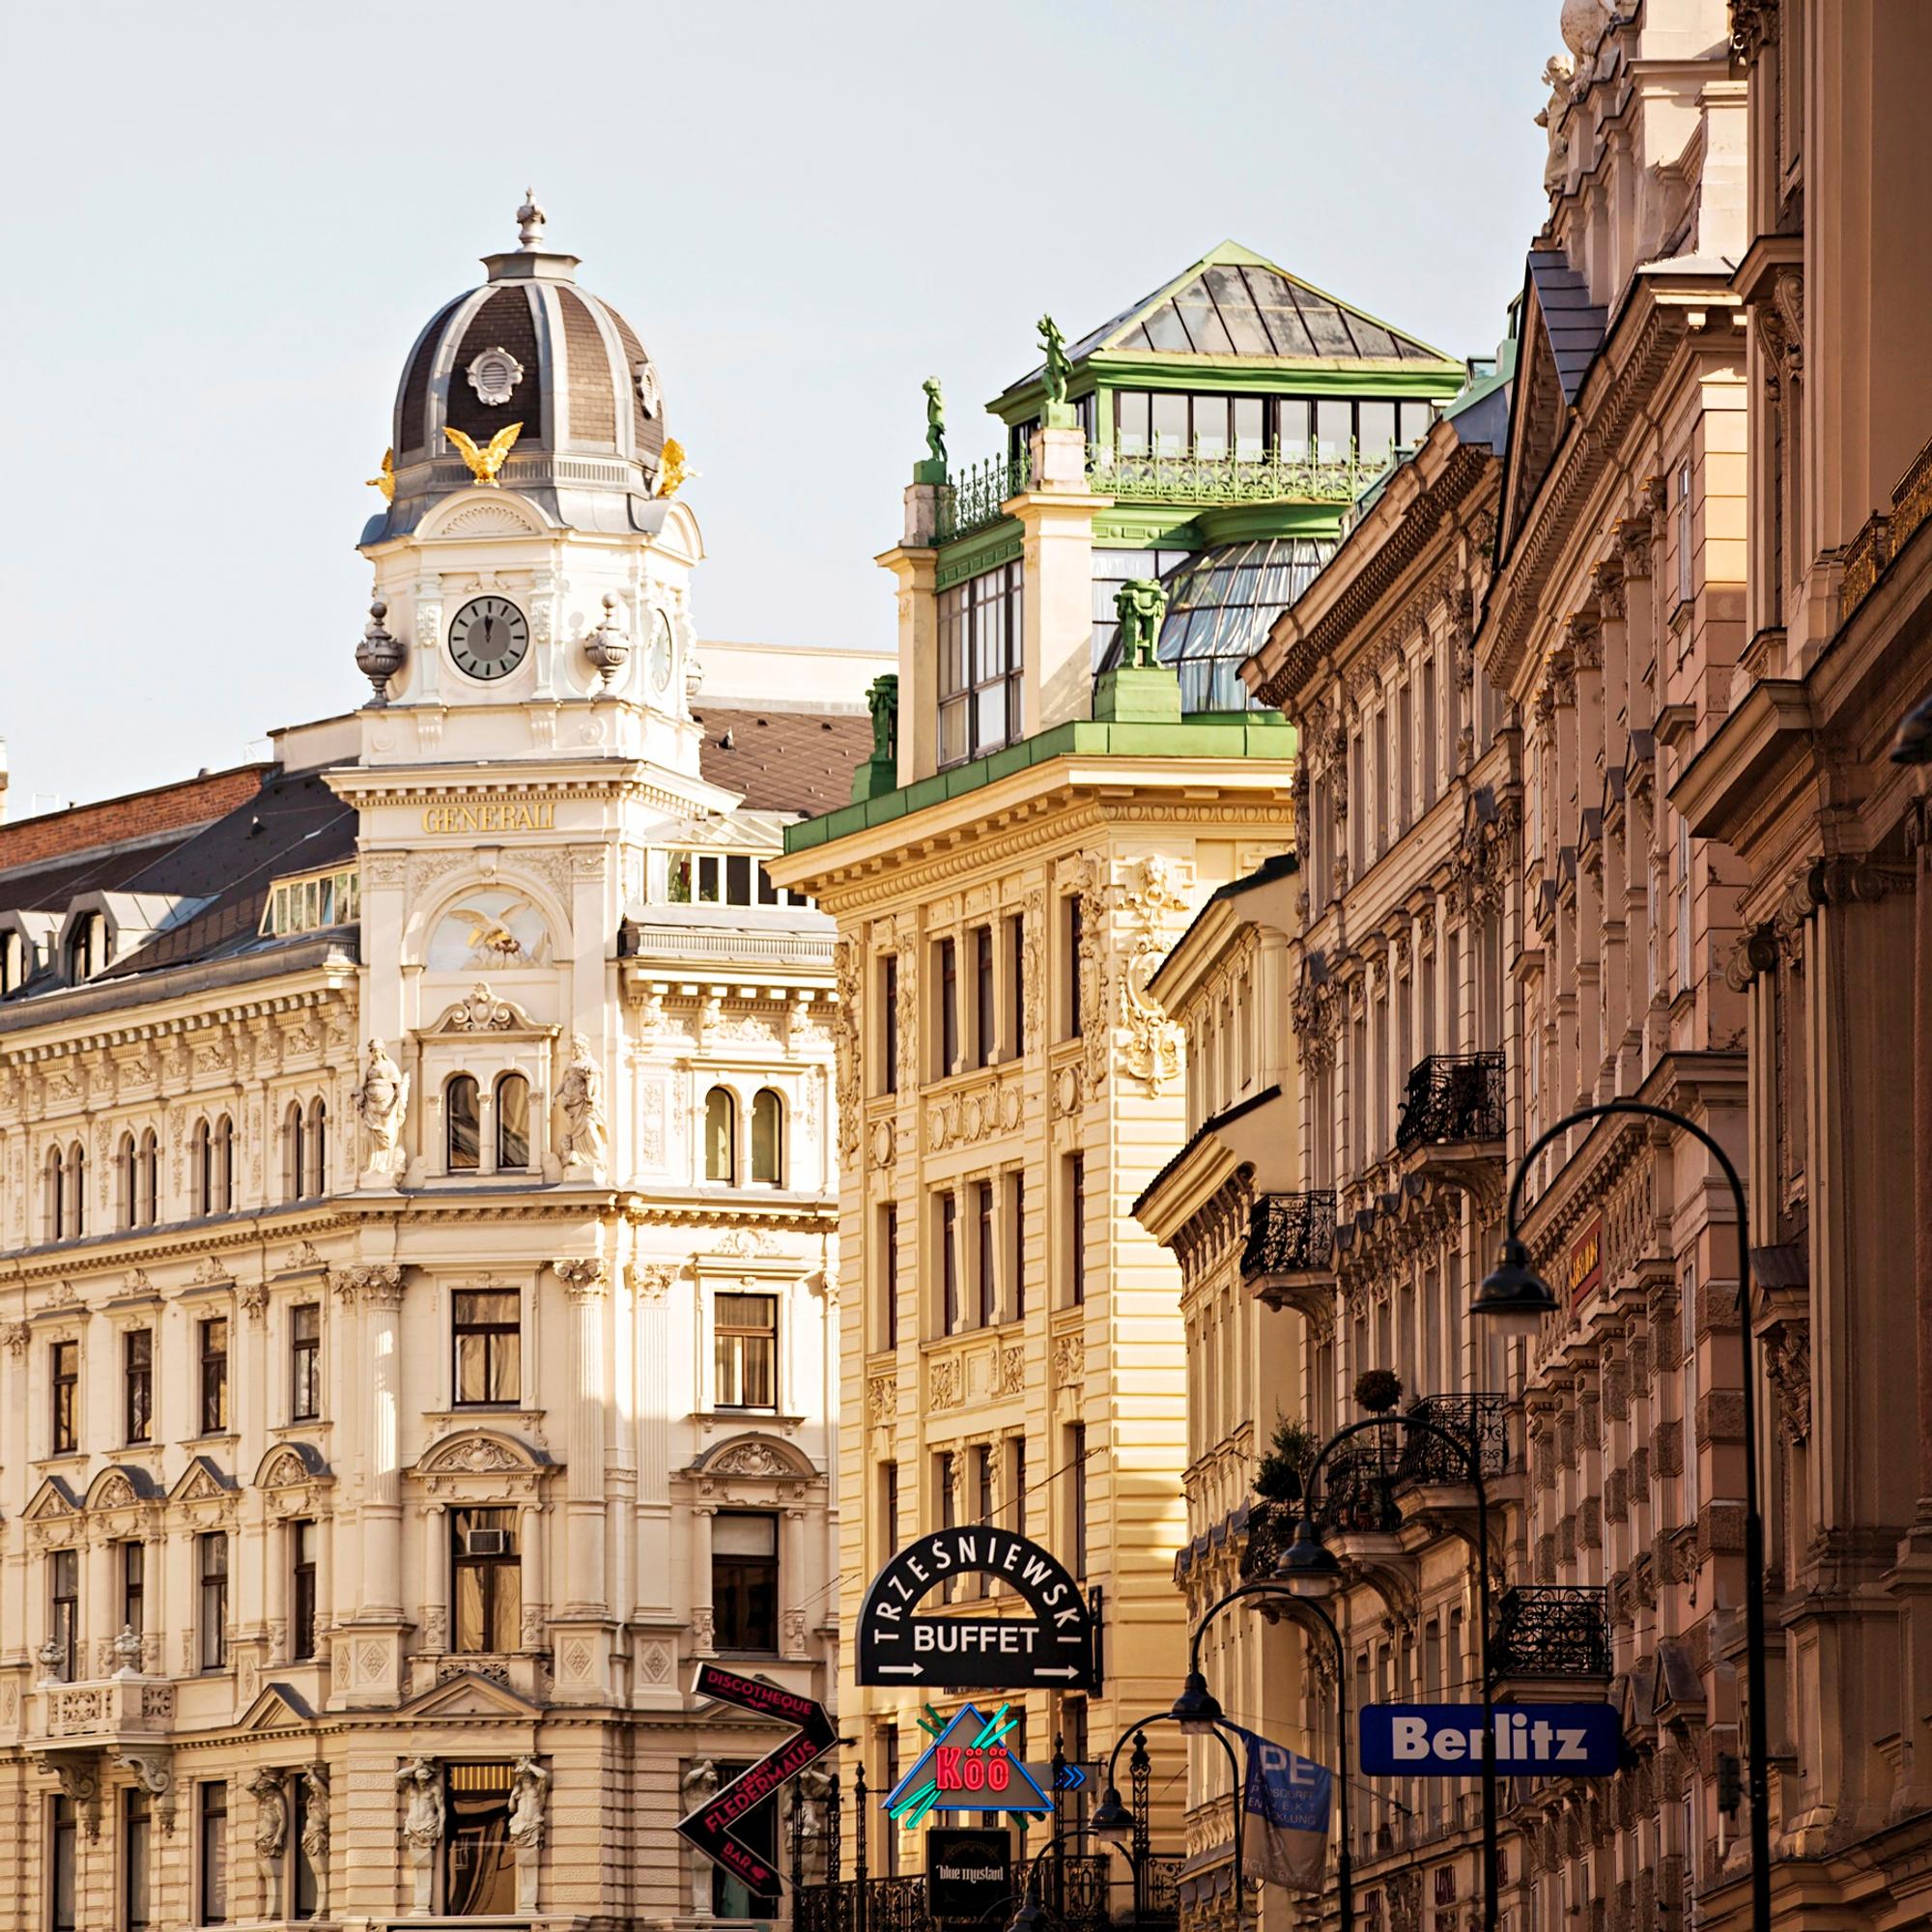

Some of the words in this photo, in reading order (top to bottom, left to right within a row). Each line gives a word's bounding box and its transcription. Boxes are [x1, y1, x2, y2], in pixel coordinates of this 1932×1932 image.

[421, 803, 556, 834] GENERALI
[914, 1625, 1039, 1653] BUFFET
[707, 1670, 813, 1716] DISCOTHEQUE
[704, 1741, 818, 1833] FLEDERMAUS
[723, 1841, 752, 1869] BAR
[934, 1863, 960, 1880] blue
